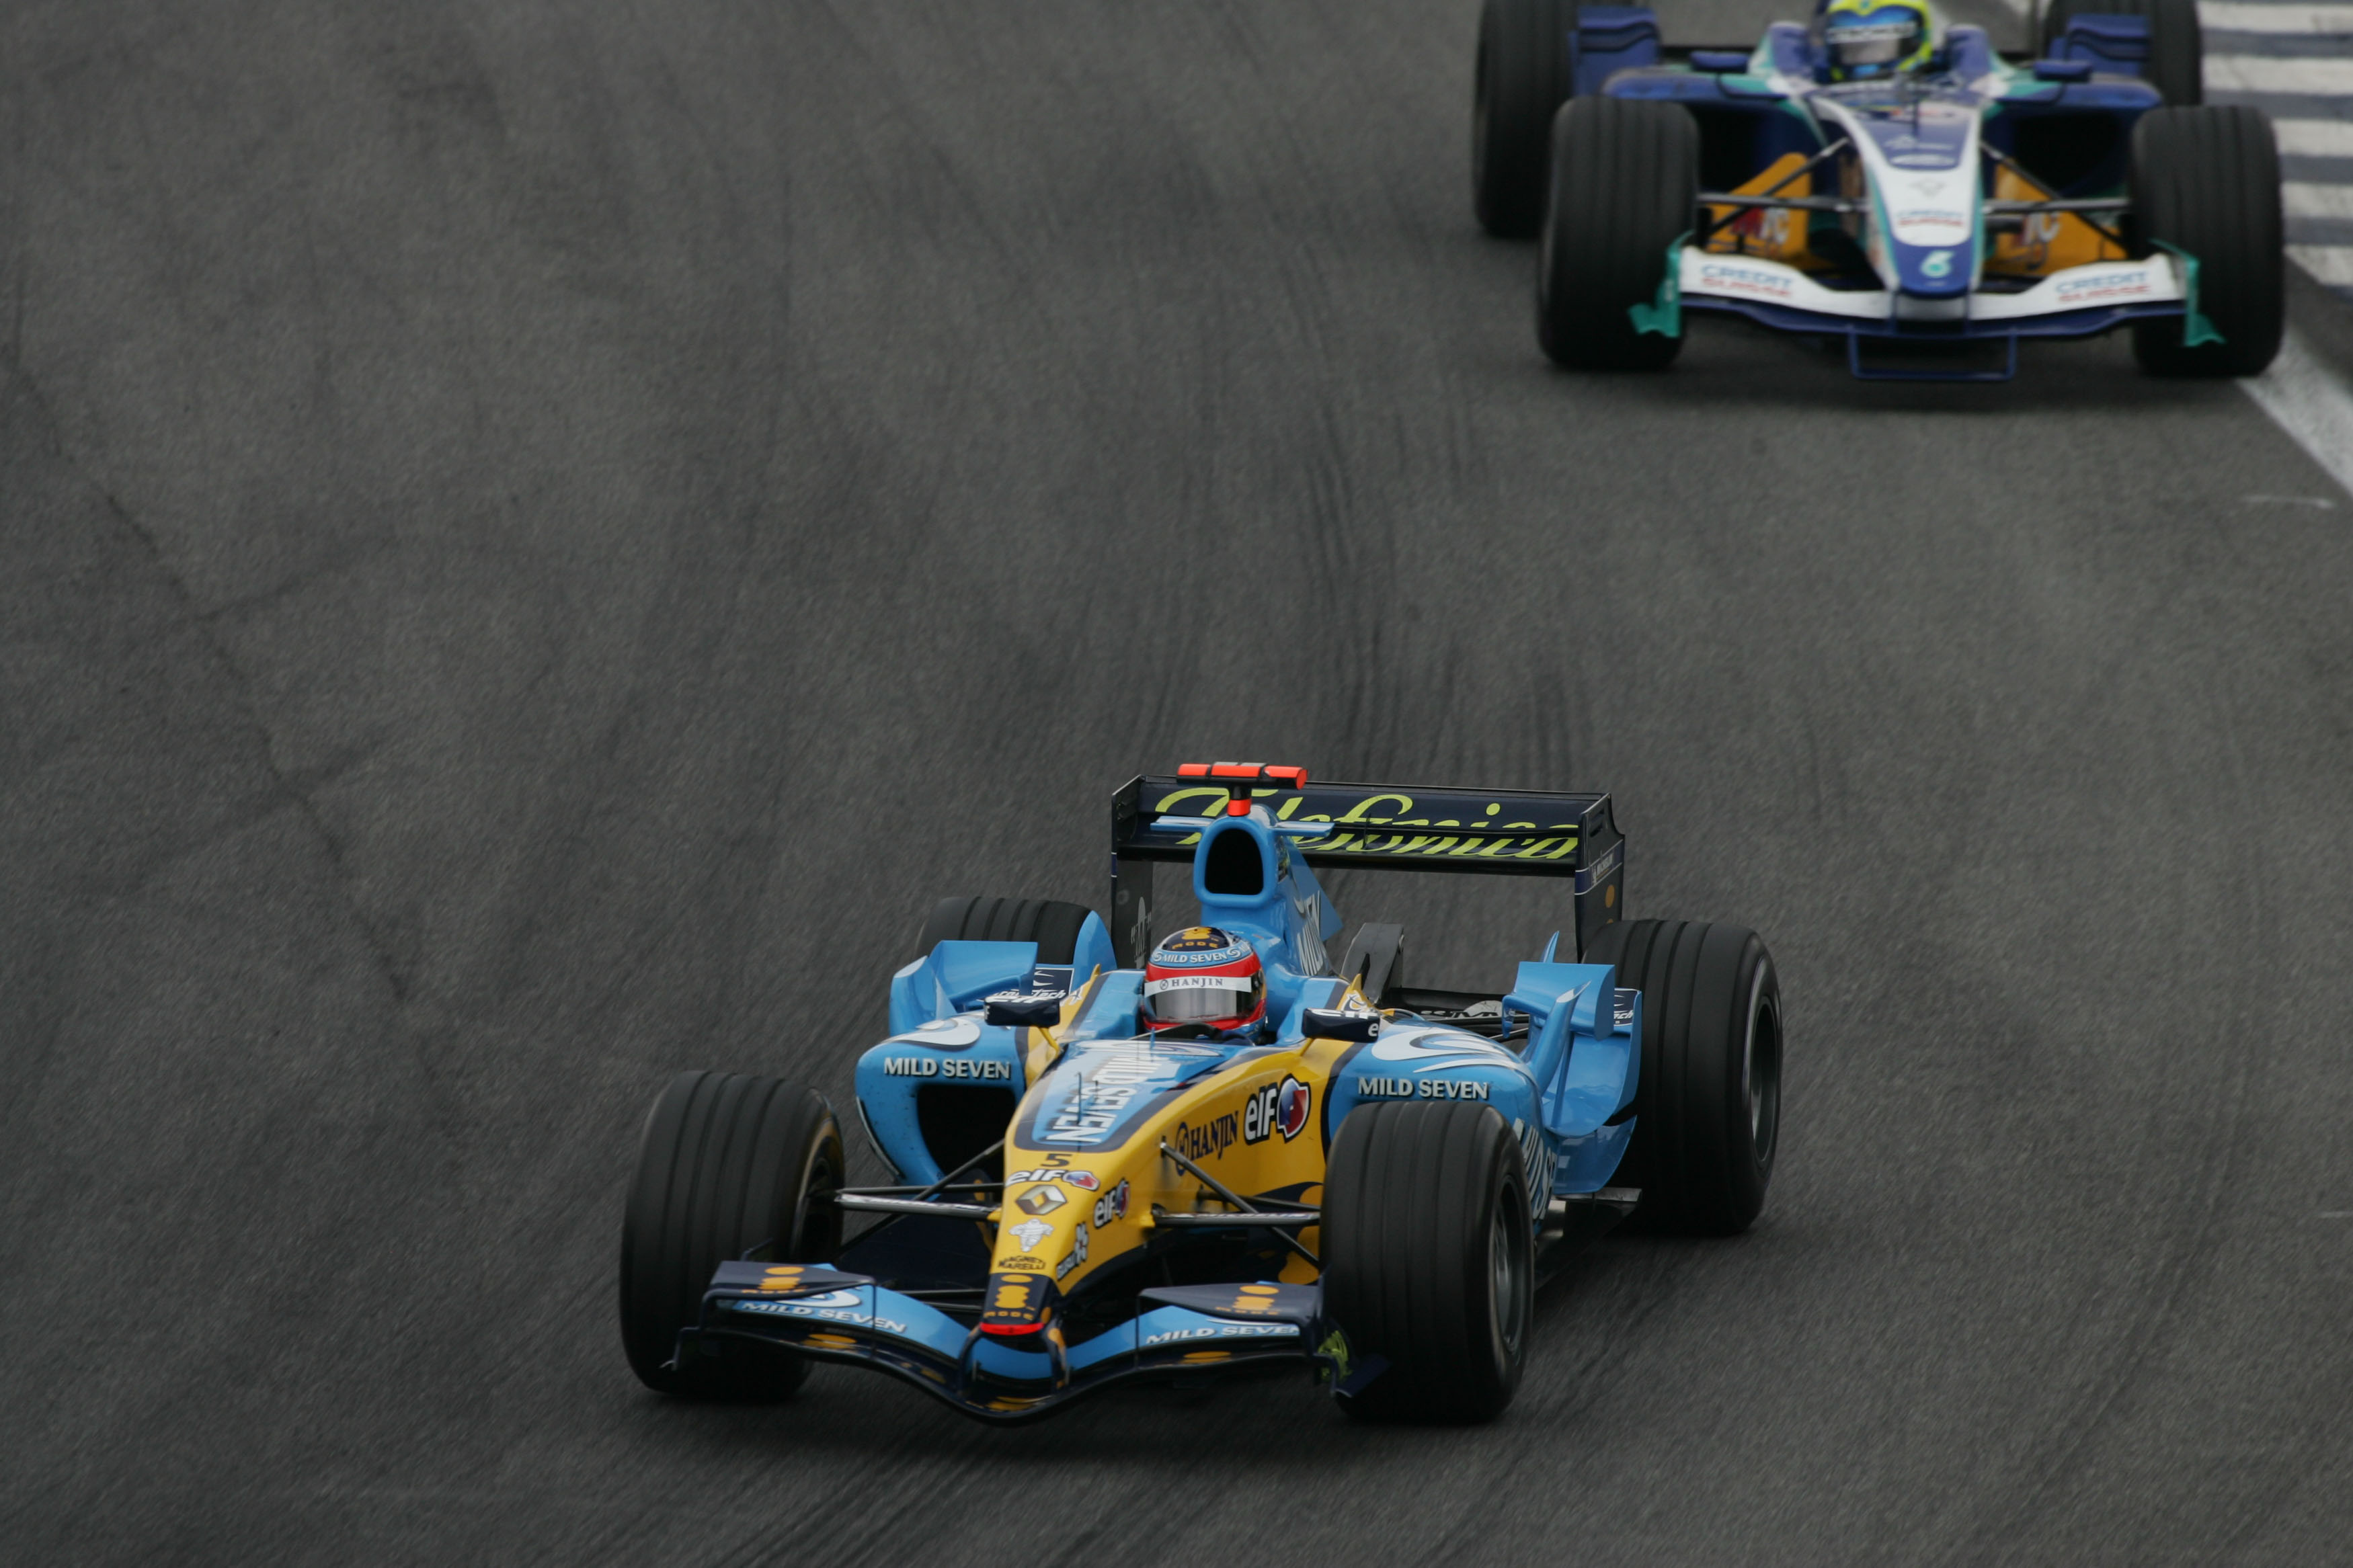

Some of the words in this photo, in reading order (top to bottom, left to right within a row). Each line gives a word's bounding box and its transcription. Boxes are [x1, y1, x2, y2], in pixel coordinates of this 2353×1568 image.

[1921, 250, 1956, 278] 6
[1162, 954, 1188, 963] MILD
[1189, 952, 1228, 963] SEVEN
[1172, 978, 1224, 987] HANJIN
[884, 1057, 938, 1077] MILD
[941, 1061, 1011, 1079] SEVEN
[1358, 1077, 1414, 1097] MILD
[1418, 1080, 1488, 1100] SEVEN
[1046, 1086, 1138, 1143] SEVEN
[1244, 1083, 1277, 1143] elf
[1189, 1110, 1239, 1161] HANJIN
[1041, 1153, 1072, 1167] 5
[1005, 1169, 1069, 1187] elf
[1094, 1188, 1118, 1229] elf
[742, 1302, 812, 1315] MILD
[817, 1309, 906, 1333] SEVEN
[1146, 1327, 1215, 1344] MILD
